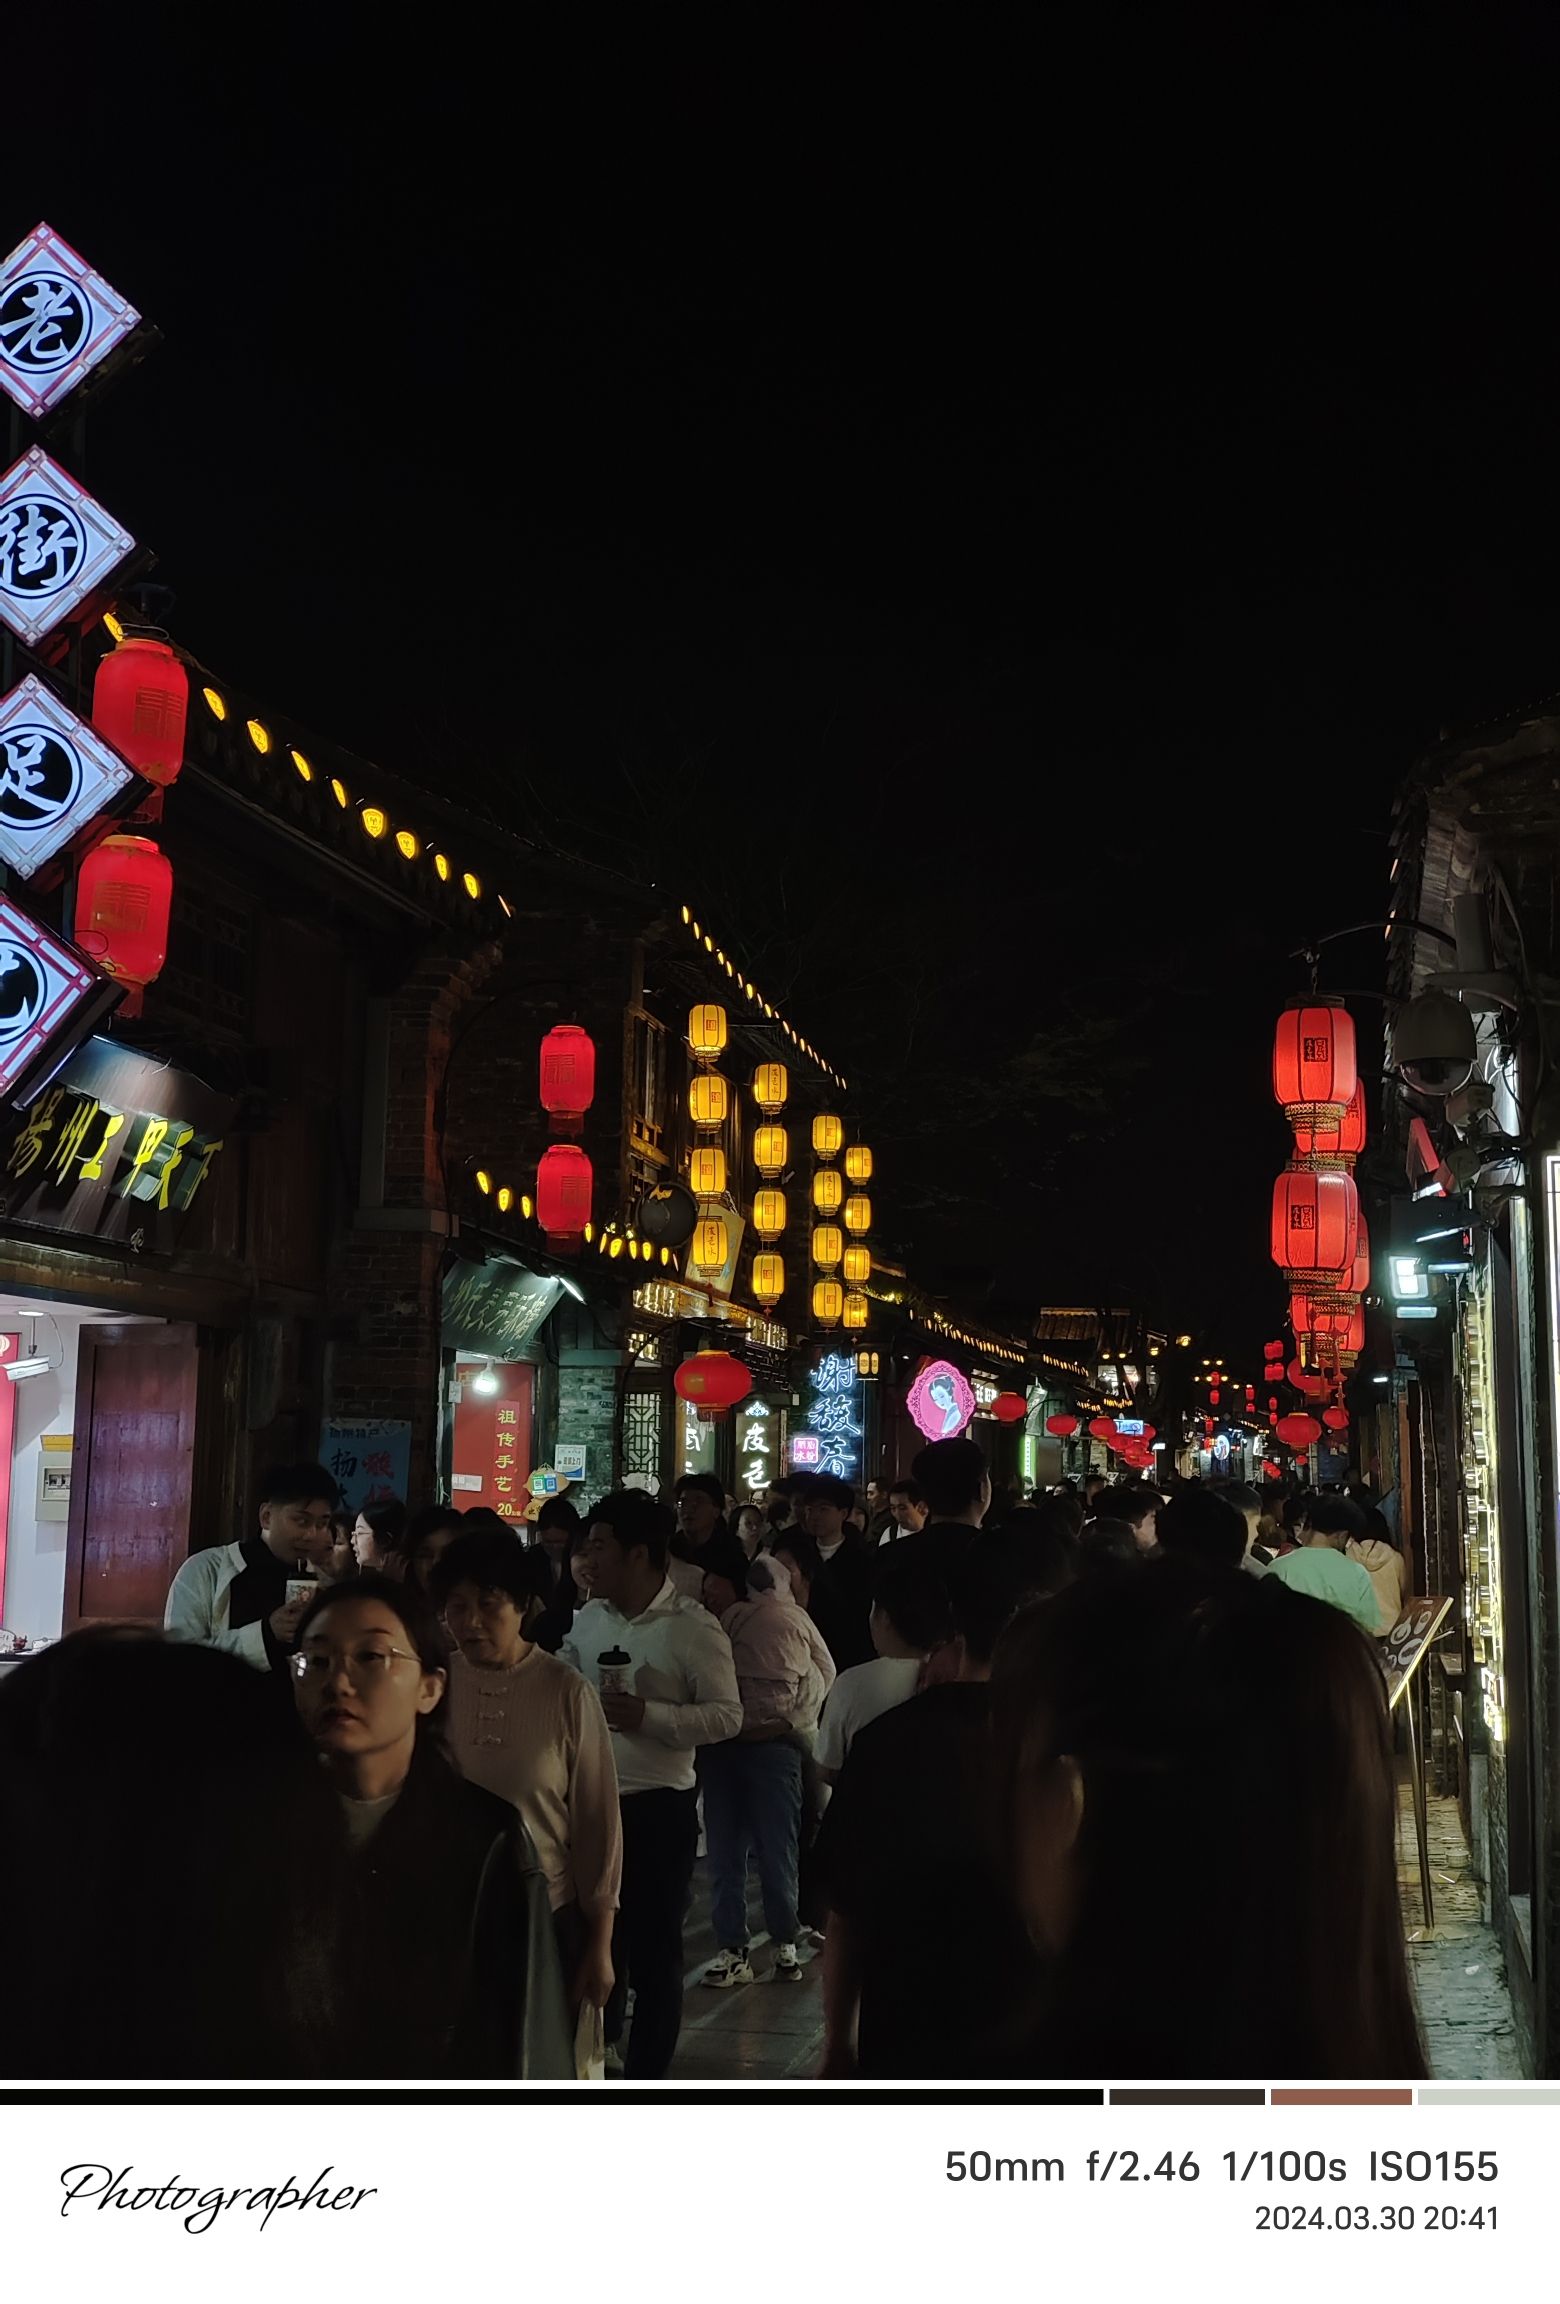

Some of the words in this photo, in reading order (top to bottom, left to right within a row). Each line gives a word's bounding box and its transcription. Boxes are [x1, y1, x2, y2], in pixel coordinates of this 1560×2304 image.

[494, 1409, 517, 1493] 祖传手艺
[808, 1354, 861, 1479] 谢馥春
